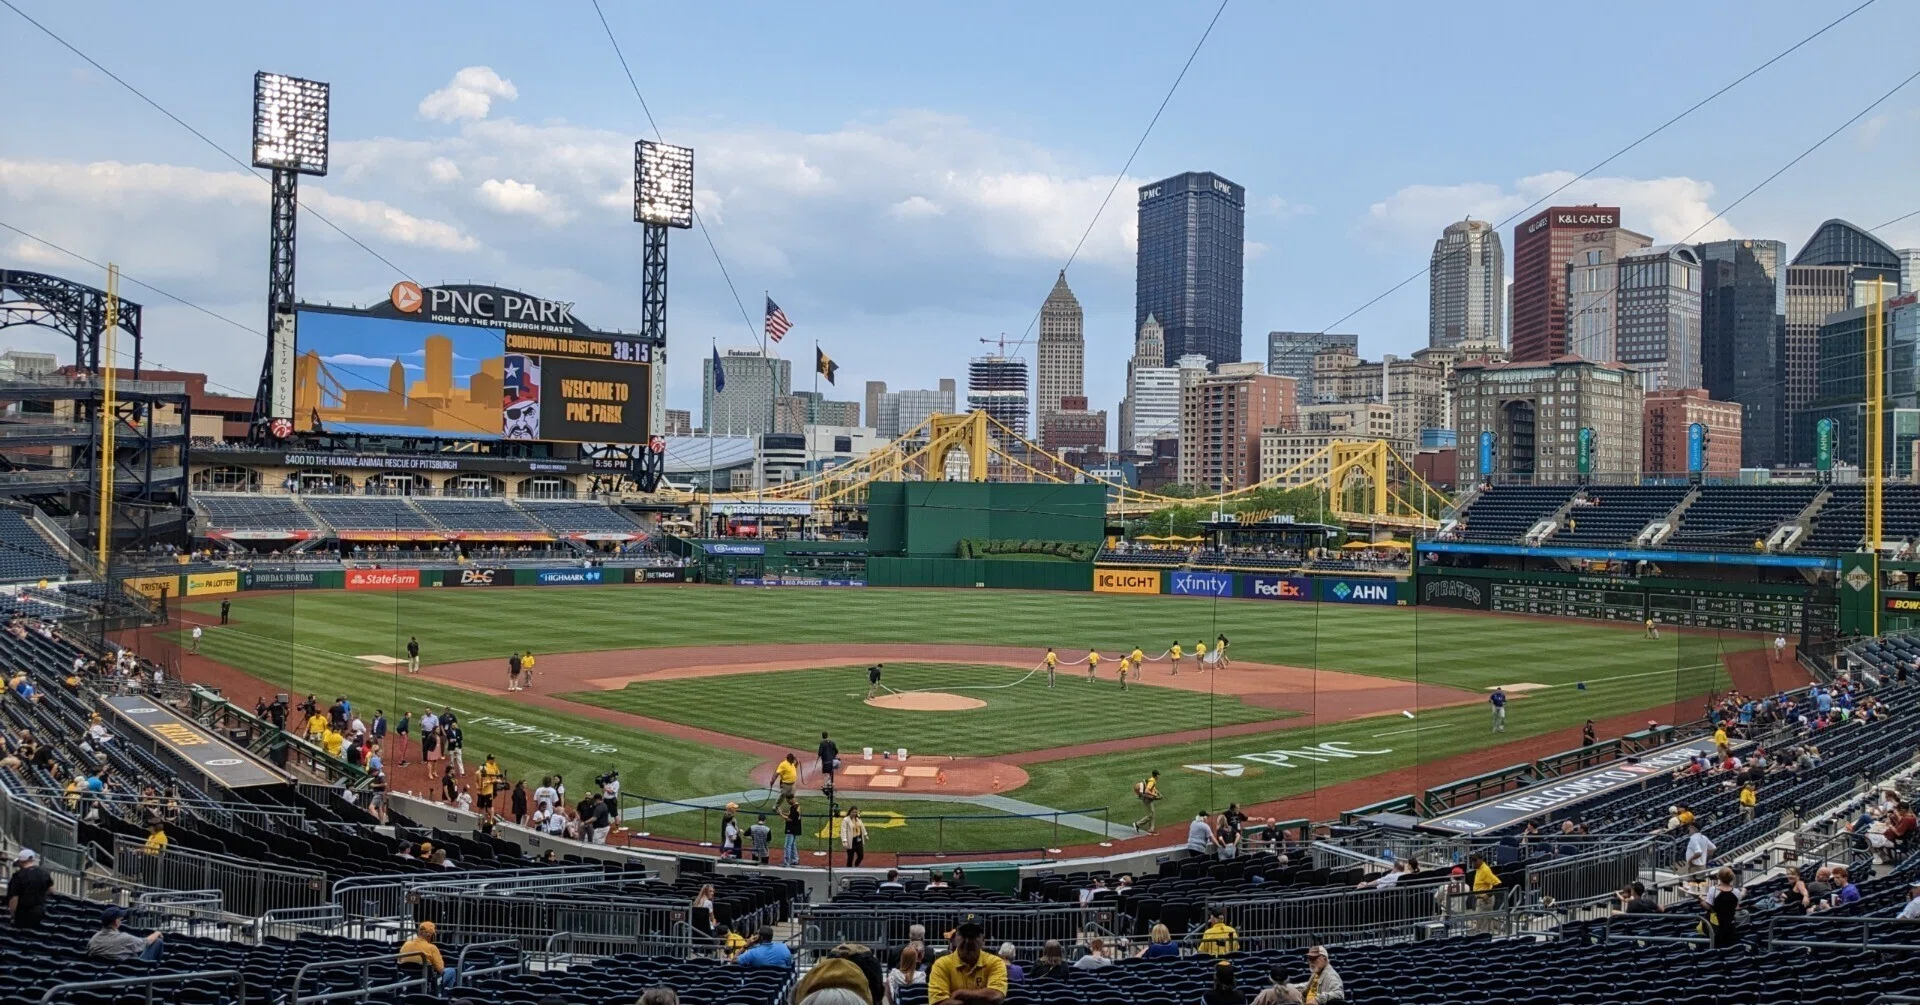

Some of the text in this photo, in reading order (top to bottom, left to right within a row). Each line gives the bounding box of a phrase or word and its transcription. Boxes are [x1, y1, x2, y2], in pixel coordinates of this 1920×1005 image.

[1140, 186, 1162, 200] UPMC
[1214, 179, 1232, 196] UPMC
[1535, 217, 1548, 230] GATES
[1558, 215, 1613, 224] K&L GATES
[1583, 232, 1606, 243] EQT
[429, 288, 574, 324] PNC PARK
[432, 314, 455, 323] HOME
[490, 320, 539, 330] PITTSBURGH
[541, 324, 573, 334] PIRATES
[507, 335, 611, 356] COUNTDOWN TO FIRST PITCH
[614, 341, 648, 362] 38:15
[280, 368, 286, 383] GO
[562, 379, 628, 401] WELCOME TO
[566, 403, 622, 423] PNC PARK
[285, 455, 457, 469] $400 TO THE HUMANE ANIMAL RESCUE OF PITTSBURGH
[737, 505, 755, 514] FAT
[1220, 508, 1294, 526] IT'S Miller TIME
[714, 544, 760, 553] Guardian
[214, 579, 236, 587] LOTTERY
[256, 574, 284, 582] BORDAS
[461, 570, 494, 583] DLC
[1100, 574, 1154, 588] IC LIGHT
[1176, 576, 1227, 596] xfinity
[1255, 580, 1299, 596] FedEx
[1353, 585, 1388, 600] AHN
[1426, 580, 1481, 606] PIRATES
[1670, 589, 1743, 598] AMERICAN
[1231, 742, 1392, 768] PNC
[1495, 777, 1616, 812] WELCOME
[1594, 770, 1638, 782] TO
